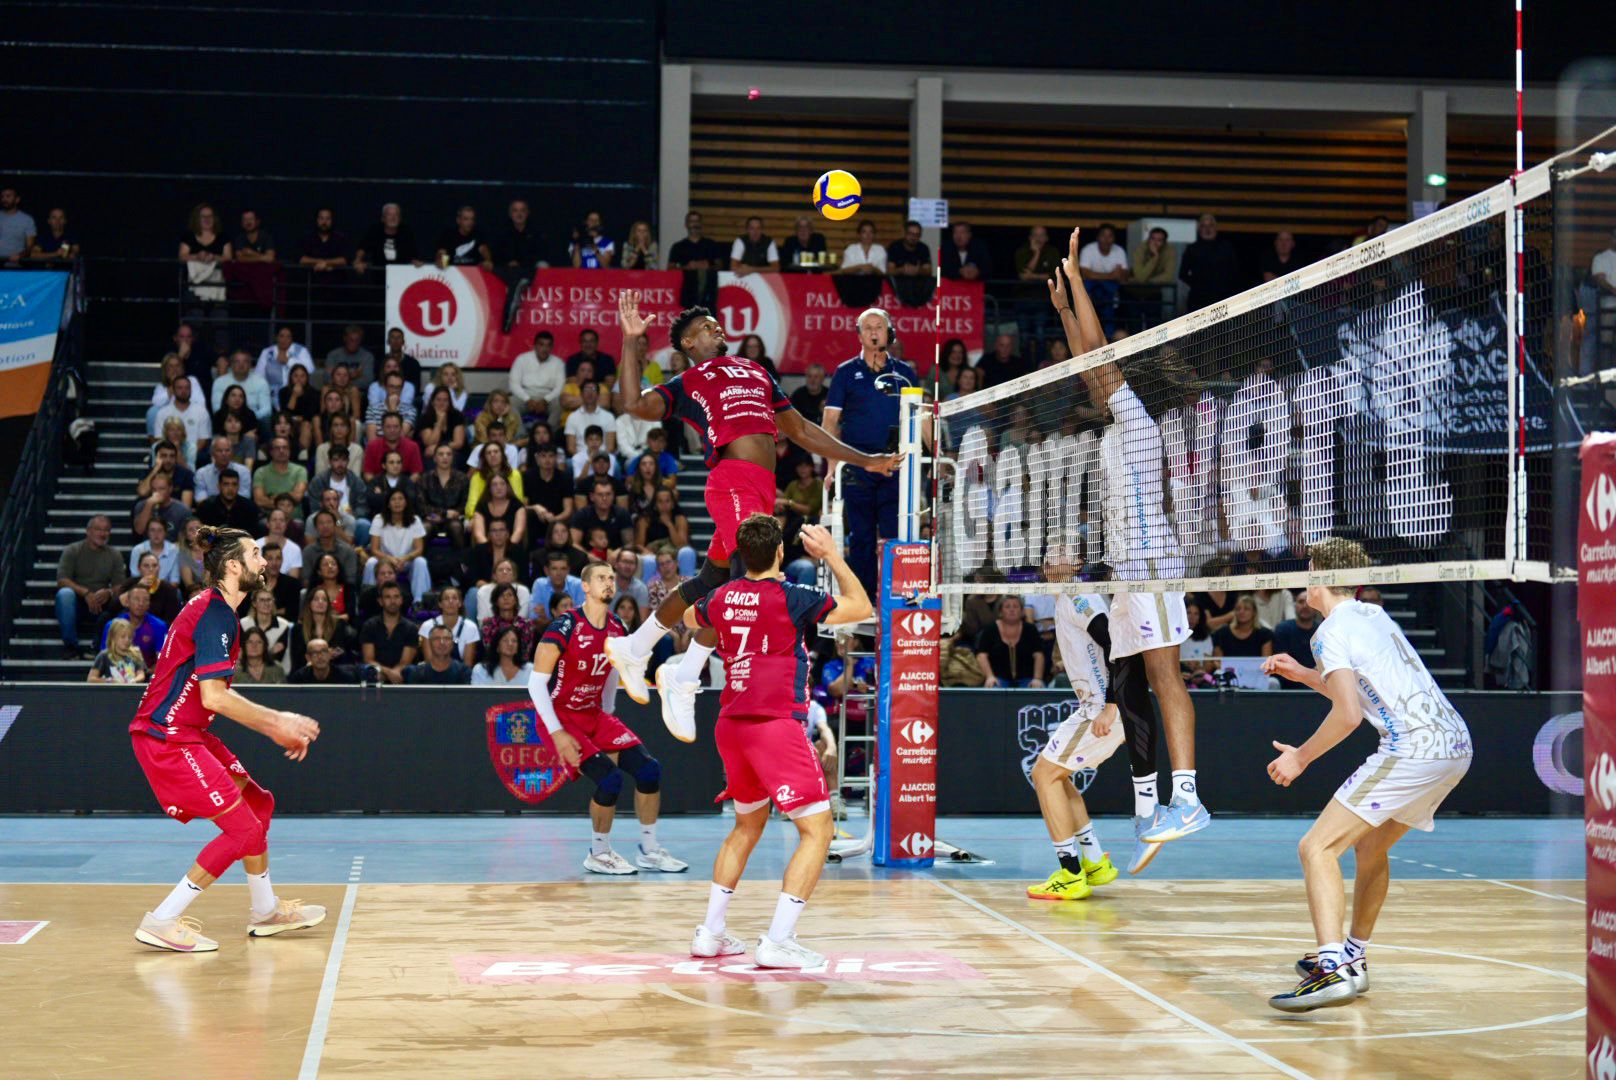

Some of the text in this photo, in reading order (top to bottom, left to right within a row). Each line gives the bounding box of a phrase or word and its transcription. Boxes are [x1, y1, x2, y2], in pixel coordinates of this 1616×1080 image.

[1466, 196, 1492, 222] CORSE
[570, 287, 603, 303] DES
[530, 308, 564, 325] DES
[804, 314, 825, 331] ET
[830, 315, 857, 332] DE
[895, 546, 930, 556] Carrefo
[902, 580, 929, 589] AJACC
[734, 608, 758, 618] FORMA
[730, 626, 751, 657] 7
[897, 638, 938, 648] Carrefour
[903, 648, 932, 656] market
[1390, 632, 1421, 673] 4
[557, 659, 566, 678] CLUB
[591, 653, 609, 676] 12
[900, 671, 935, 681] AJACCIO
[898, 682, 937, 692] Albert 1er
[1359, 678, 1380, 705] CLUB
[902, 756, 932, 764] market
[901, 782, 935, 792] AJACCIO
[209, 790, 225, 807] 6
[899, 793, 924, 803] Albert
